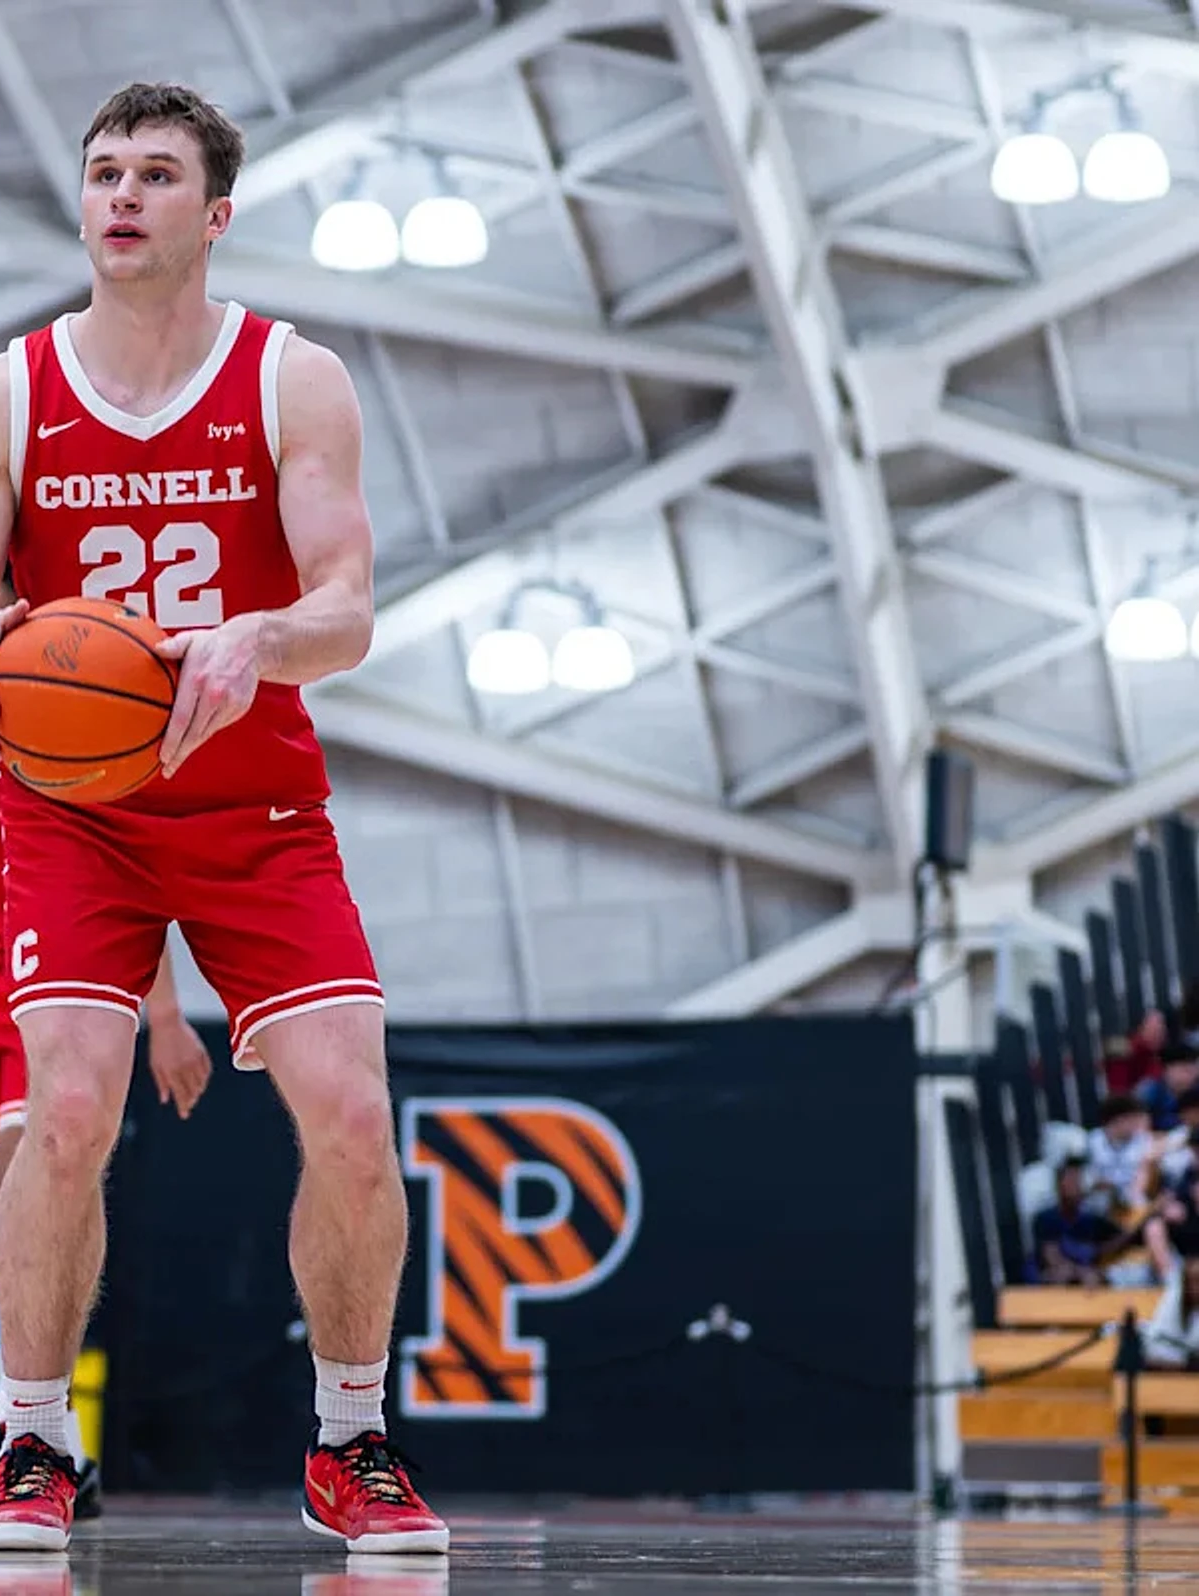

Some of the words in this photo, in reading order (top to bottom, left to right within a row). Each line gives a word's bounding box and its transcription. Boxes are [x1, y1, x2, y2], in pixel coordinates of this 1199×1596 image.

[206, 421, 233, 442] Ivy
[35, 467, 257, 509] CORNELL
[78, 521, 224, 628] 22
[10, 927, 40, 983] C
[400, 1096, 643, 1419] P
